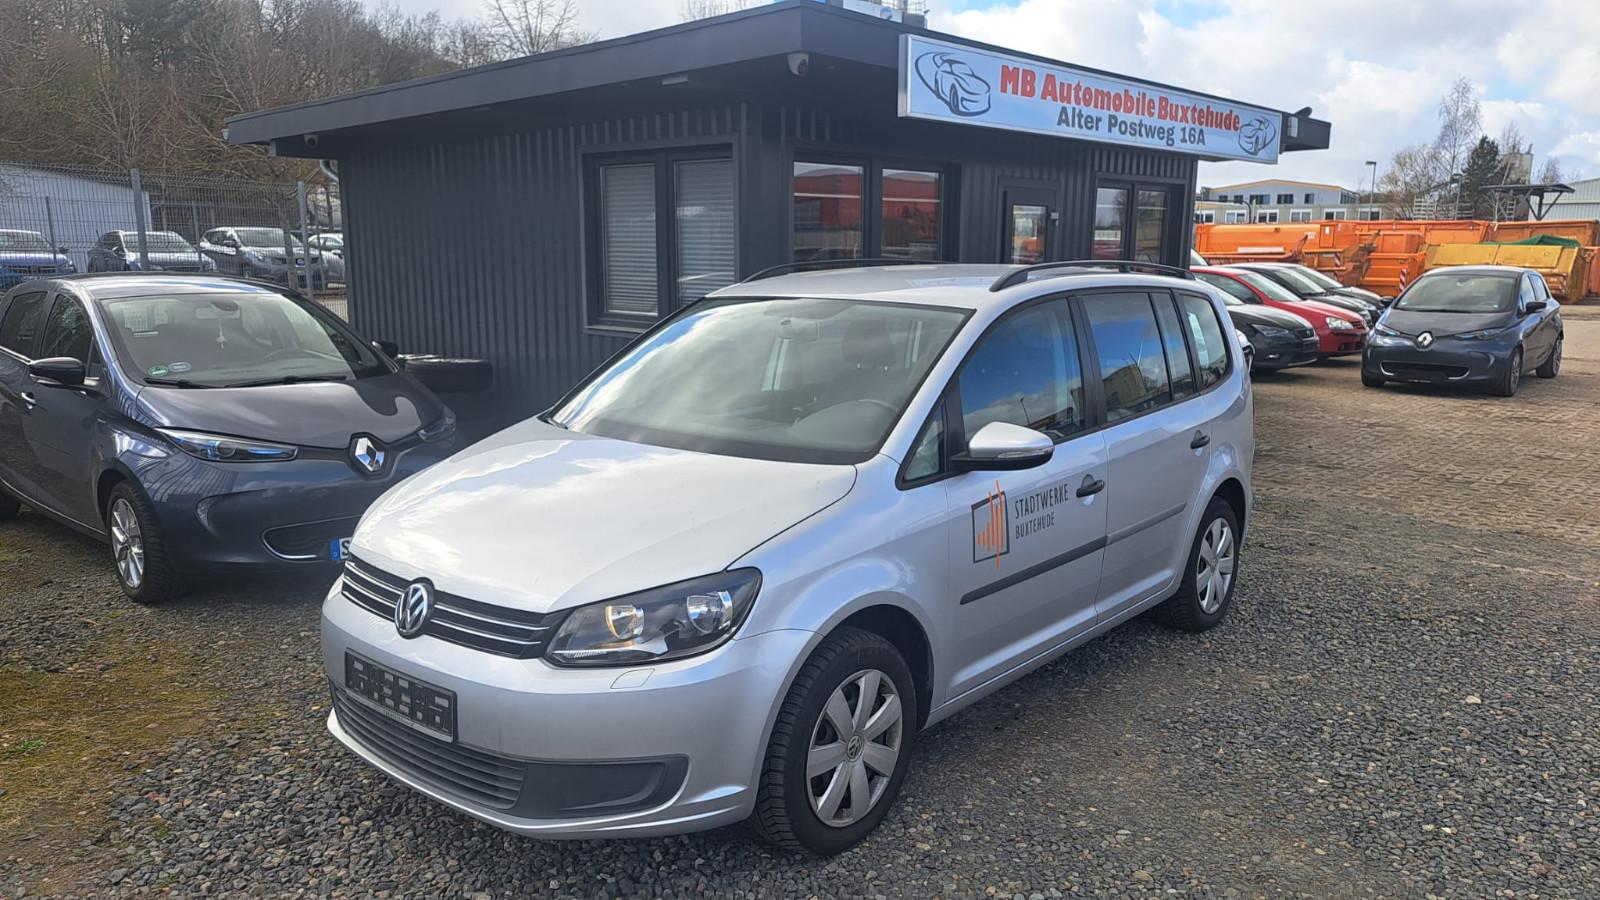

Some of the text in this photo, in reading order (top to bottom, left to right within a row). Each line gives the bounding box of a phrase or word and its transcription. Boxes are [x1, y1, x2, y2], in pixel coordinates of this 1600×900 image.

[1000, 64, 1036, 97] MB
[1057, 106, 1206, 147] Alter Postweg 16A
[1015, 483, 1069, 519] STADTWERKE
[1015, 512, 1055, 539] BUXTEHUDE
